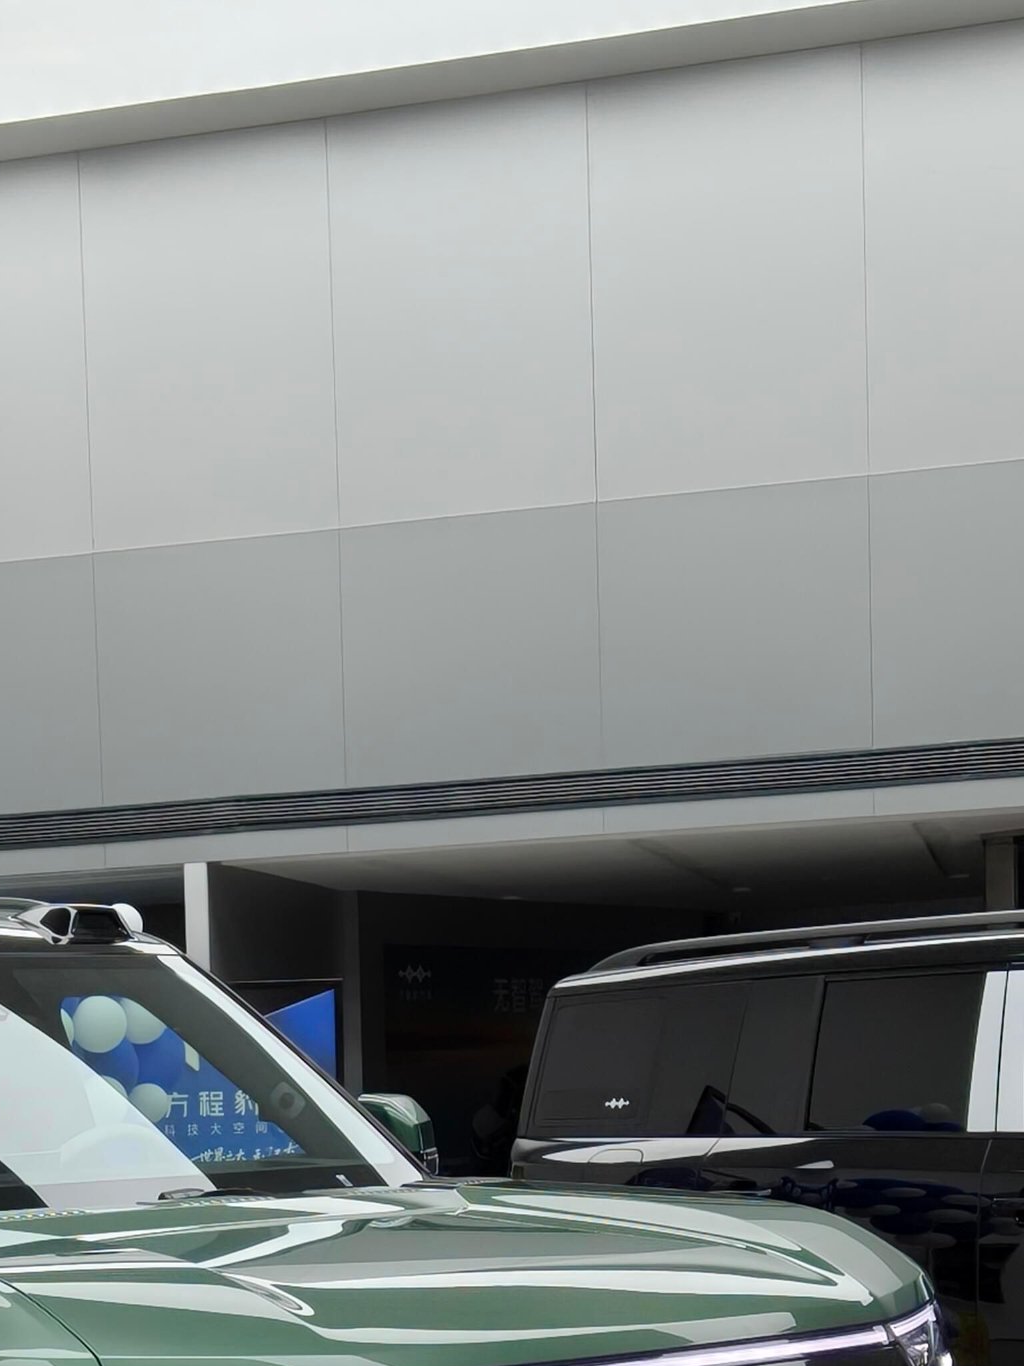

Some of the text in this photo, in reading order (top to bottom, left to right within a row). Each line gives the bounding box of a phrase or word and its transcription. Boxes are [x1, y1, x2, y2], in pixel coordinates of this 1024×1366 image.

[164, 1121, 268, 1137] 科技大空间
